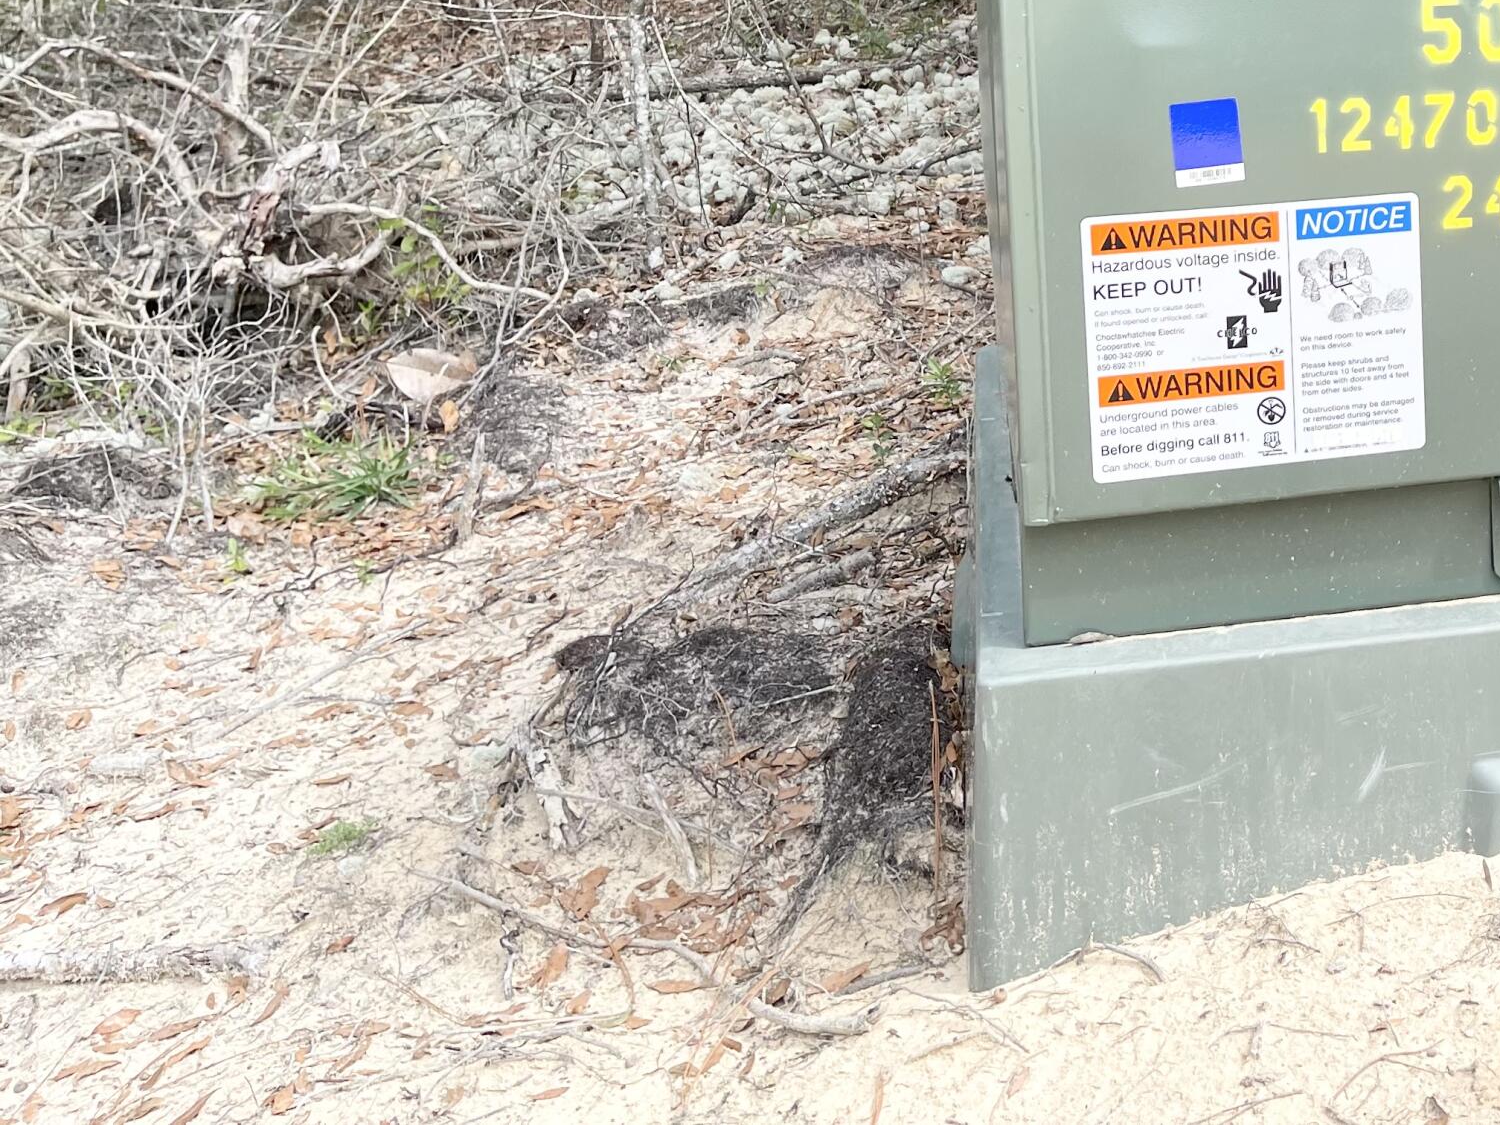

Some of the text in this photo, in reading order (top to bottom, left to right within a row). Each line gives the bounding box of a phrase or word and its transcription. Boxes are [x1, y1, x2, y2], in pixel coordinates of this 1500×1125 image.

[1302, 206, 1406, 235] NOTICE
[1129, 216, 1272, 248] WARNING
[1092, 249, 1280, 274] Hazardous voltage inside.
[1093, 277, 1201, 300] KEEP OUT!
[1385, 327, 1406, 335] safely
[1348, 357, 1373, 365] shrubs
[1136, 365, 1277, 399] WARNING
[1350, 375, 1371, 383] doors
[1100, 402, 1238, 424] Underground power cables
[1303, 406, 1350, 414] Obstructions
[1381, 397, 1414, 406] damaged
[1313, 413, 1345, 421] removed
[1100, 428, 1116, 437] are
[1120, 423, 1156, 435] located
[1160, 421, 1170, 430] in
[1172, 418, 1190, 429] this
[1303, 423, 1343, 432] restoration
[1101, 432, 1250, 457] Before digging call 811.
[1102, 464, 1120, 473] Can
[1123, 460, 1152, 471] shock,
[1155, 457, 1175, 467] burn
[1179, 456, 1187, 465] or
[1190, 454, 1216, 463] cause
